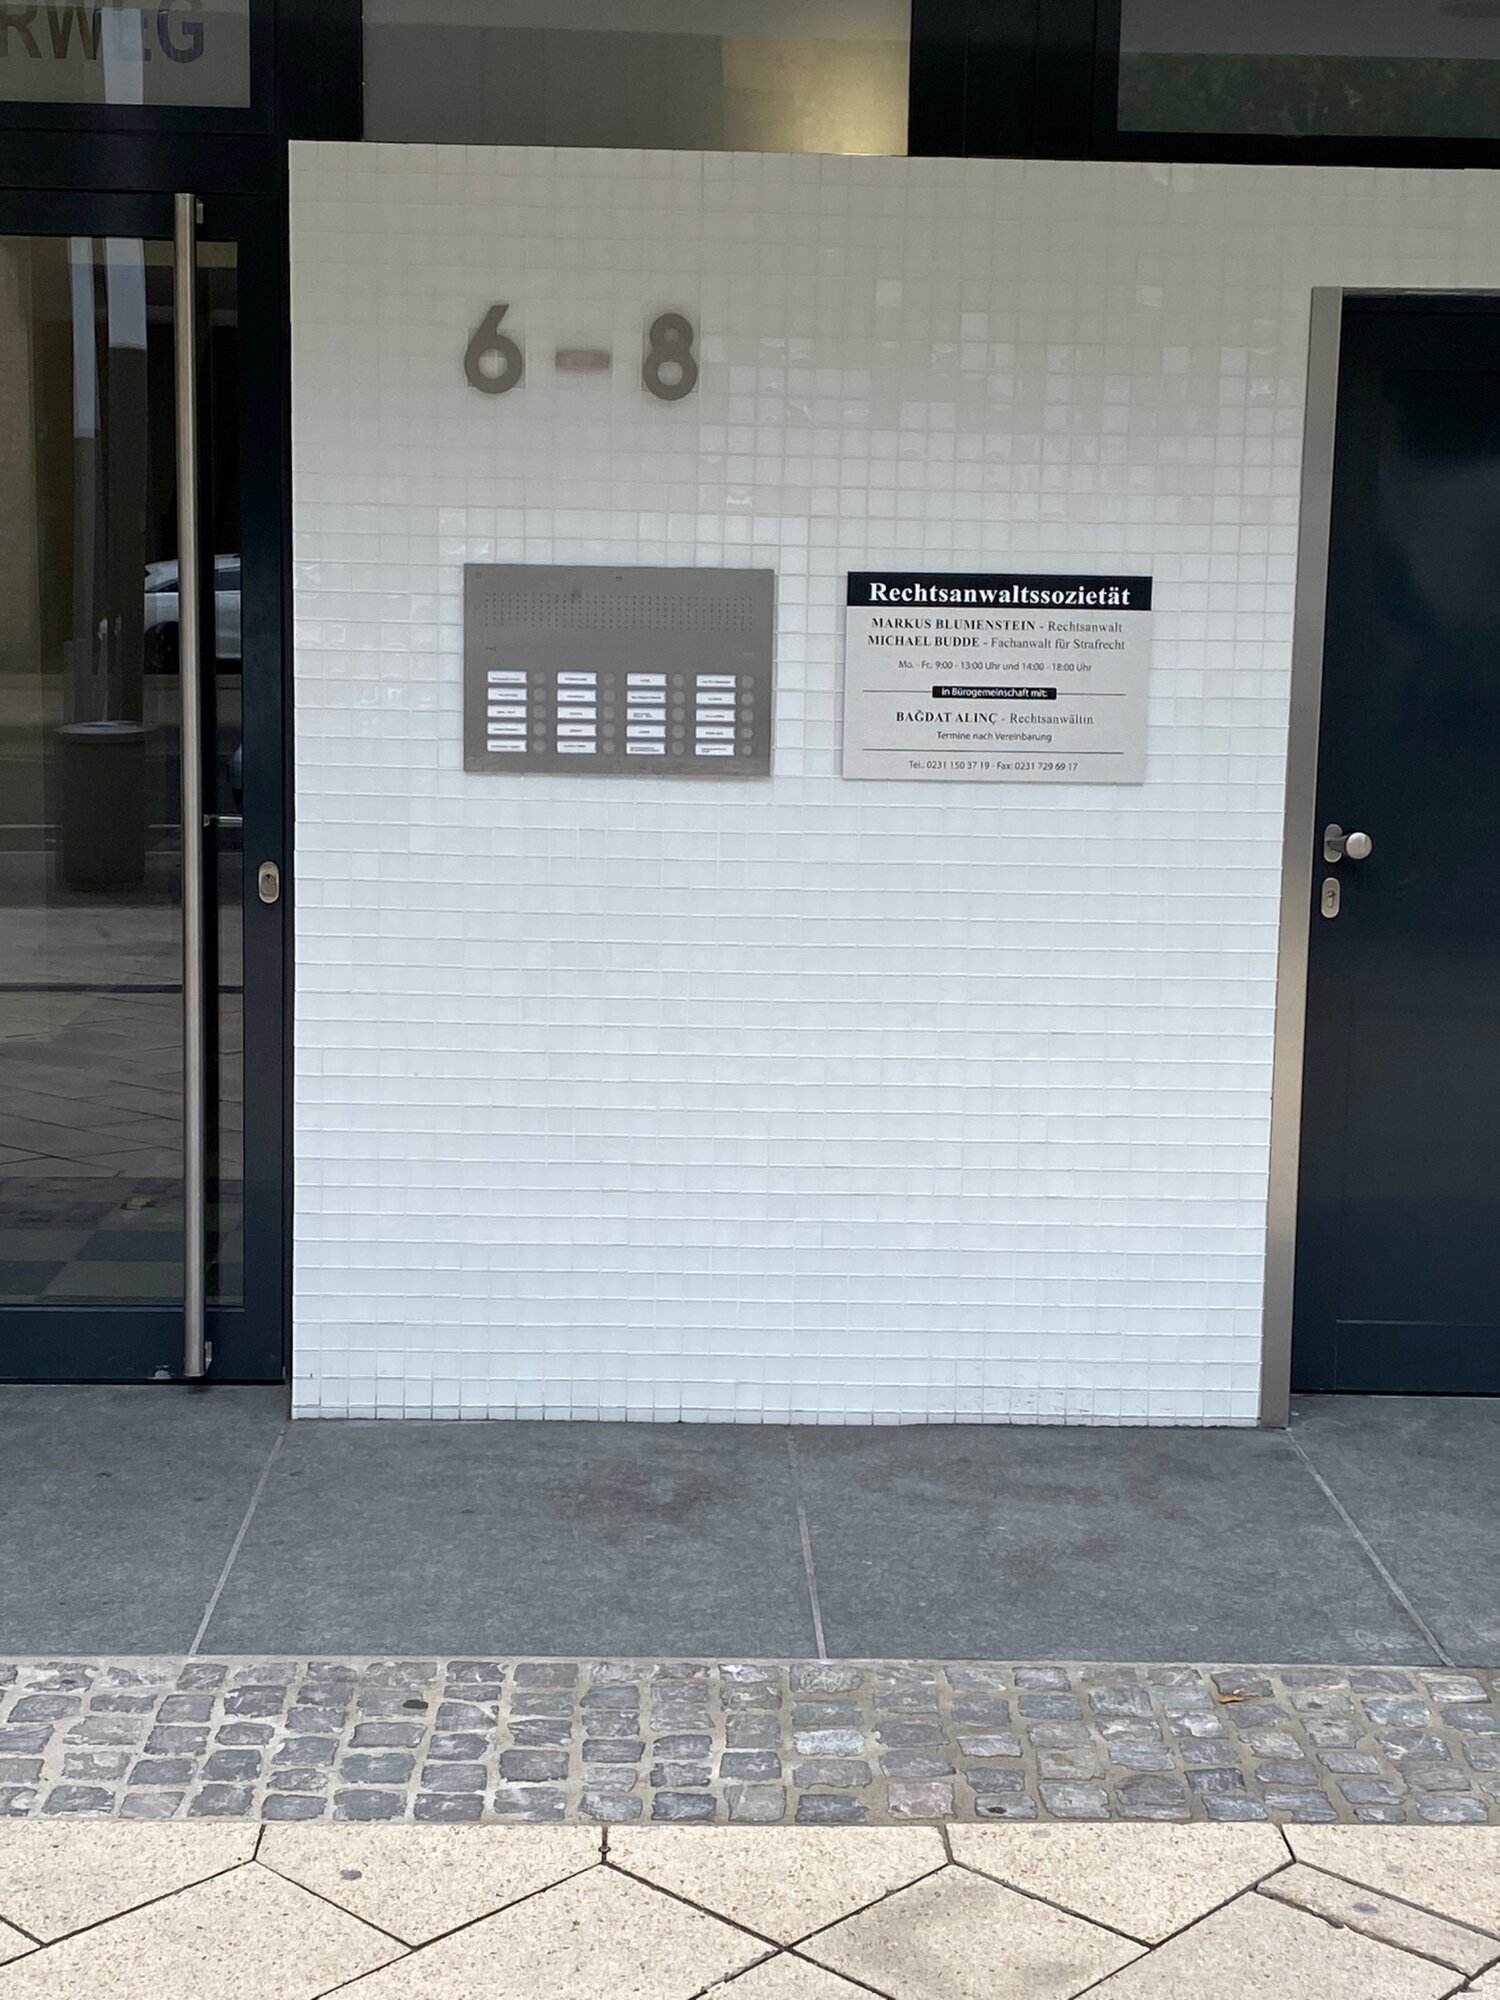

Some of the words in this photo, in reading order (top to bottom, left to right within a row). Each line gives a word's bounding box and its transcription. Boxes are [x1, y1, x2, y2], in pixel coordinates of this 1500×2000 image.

[869, 582, 1131, 606] Rechtsanwaltssozietät
[871, 617, 932, 630] MARKUS
[935, 618, 1036, 632] BLUMENSTEIN
[1047, 620, 1123, 633] Rechtsanwalt
[867, 634, 932, 647] MICHAEL
[934, 635, 980, 648] BUDDE
[990, 637, 1052, 650] Fachanwalt
[1054, 638, 1071, 650] für
[1073, 638, 1126, 651] Strafrecht
[935, 660, 954, 671] 9:00
[961, 661, 983, 671] 13:00
[985, 661, 1001, 671] Uhr
[1002, 662, 1020, 671] und
[1022, 662, 1045, 672] 14:00
[1052, 663, 1075, 673] 18:00
[1076, 663, 1092, 673] Uhr
[952, 687, 1029, 699] Bürogemeinschaft
[895, 709, 952, 723] BAĞDAT
[954, 711, 999, 725] ALINÇ
[1009, 712, 1094, 725] Rechtsanwältin
[936, 731, 971, 741] Termine
[972, 732, 994, 741] nach
[995, 732, 1053, 744] Vereinbarung
[926, 760, 947, 770] 0231
[949, 760, 966, 770] 150
[967, 761, 978, 771] 37
[979, 761, 991, 771] 19
[1014, 761, 1036, 772] 0231
[1038, 762, 1054, 772] 729
[1055, 762, 1067, 772] 69
[1068, 762, 1079, 772] 17
